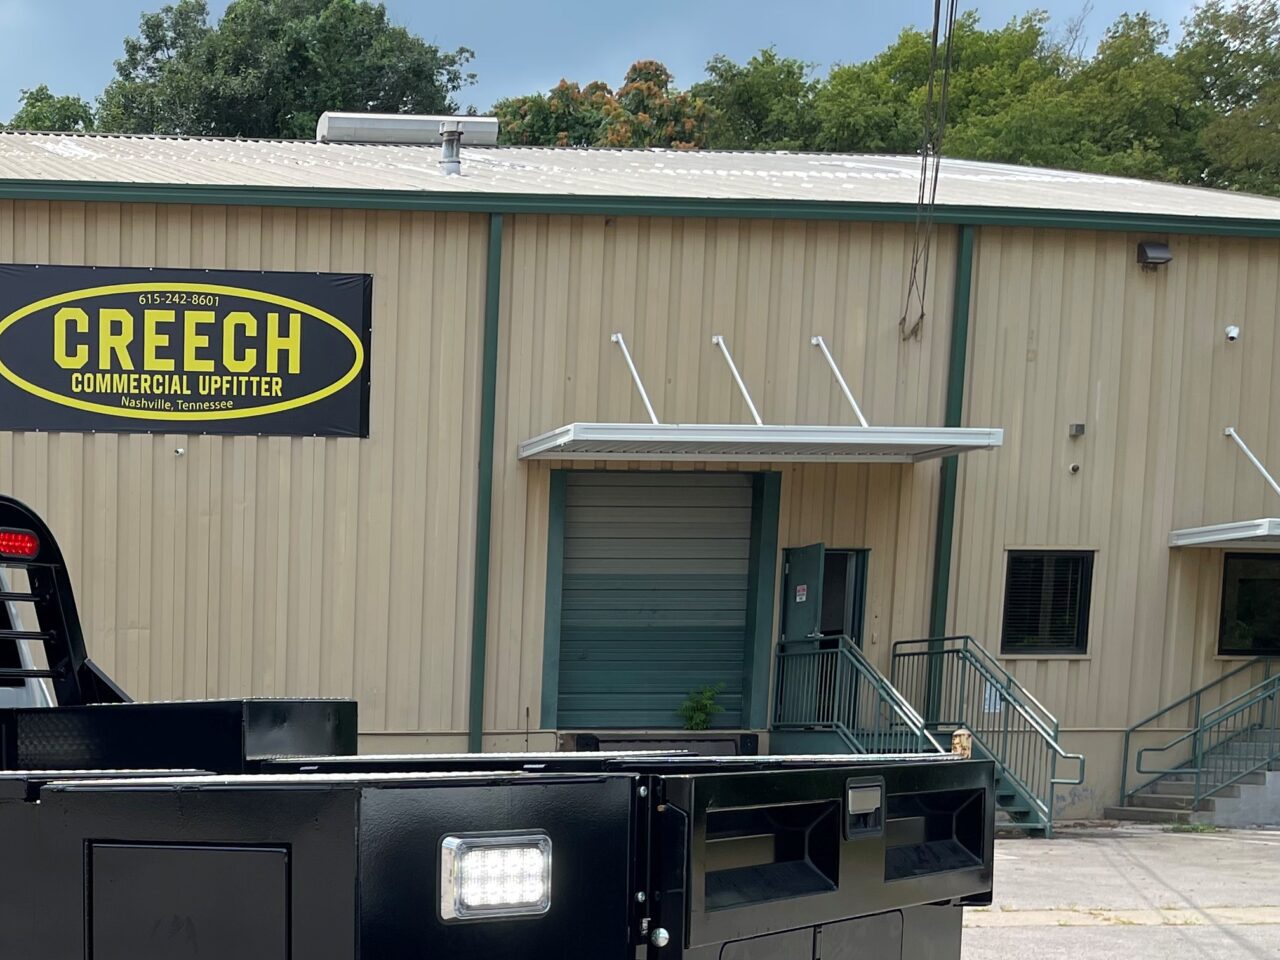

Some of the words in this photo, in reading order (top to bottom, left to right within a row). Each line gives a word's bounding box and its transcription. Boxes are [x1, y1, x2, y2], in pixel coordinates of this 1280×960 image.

[138, 293, 220, 307] 615-242-8601
[53, 307, 301, 374] CREECH
[71, 372, 192, 395] COMMERCIAL
[198, 375, 283, 397] UPFITTER
[121, 395, 174, 412] Nashville,
[176, 398, 233, 411] Tennessee
